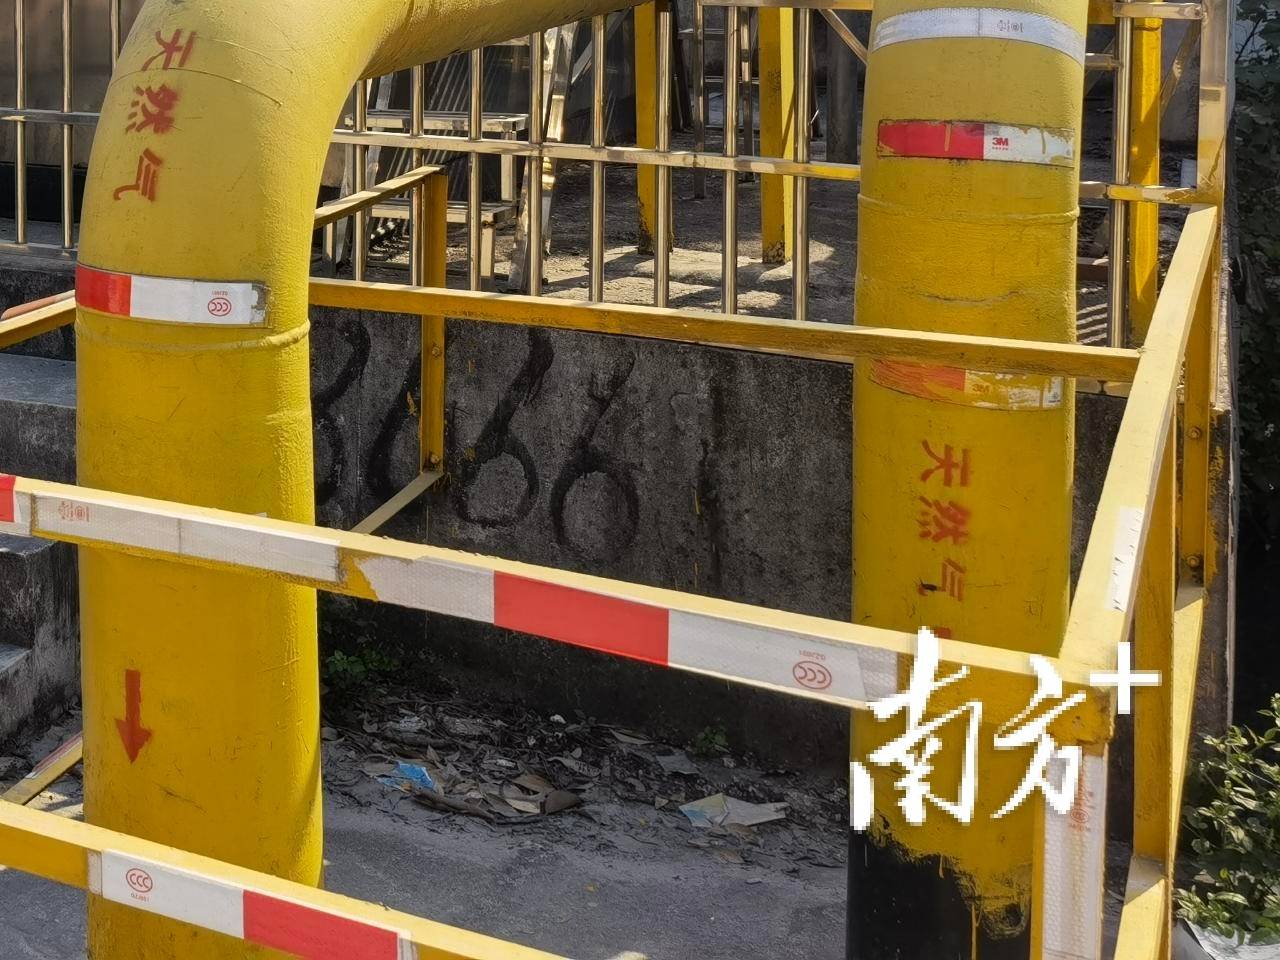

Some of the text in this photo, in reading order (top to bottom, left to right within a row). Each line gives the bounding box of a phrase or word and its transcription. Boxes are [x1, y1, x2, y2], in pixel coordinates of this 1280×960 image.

[113, 28, 198, 202] 天然气
[991, 137, 1009, 147] 3M
[917, 440, 973, 602] 天然气
